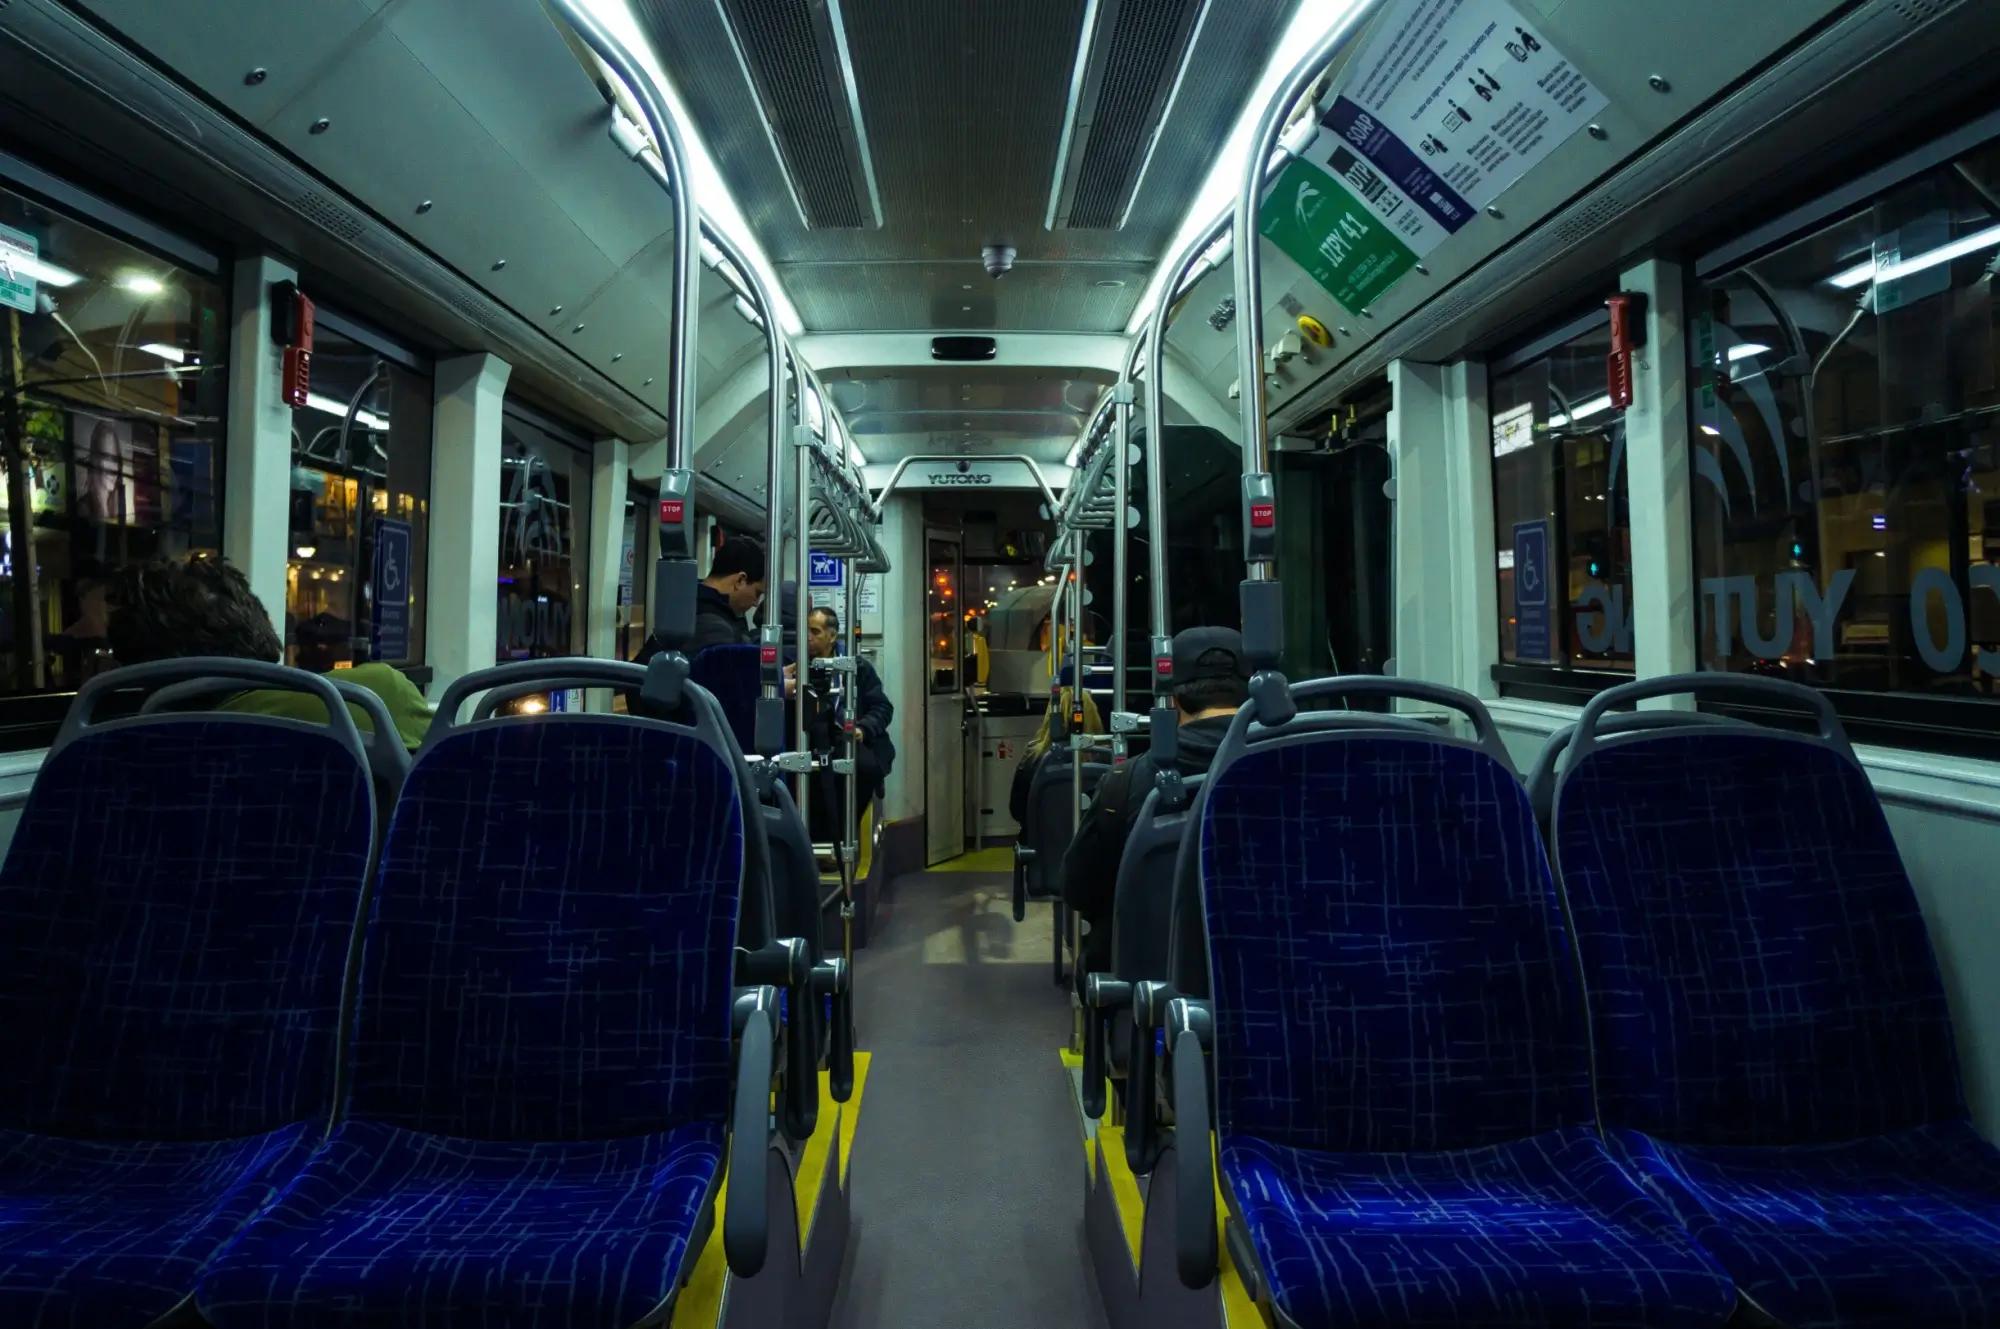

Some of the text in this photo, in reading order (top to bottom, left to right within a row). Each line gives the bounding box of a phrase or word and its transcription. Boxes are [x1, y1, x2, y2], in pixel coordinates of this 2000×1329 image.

[1346, 113, 1375, 146] SOAP
[1344, 160, 1373, 191] DTP
[1319, 227, 1352, 268] JZPY
[1339, 211, 1370, 240] 41
[928, 474, 992, 485] YUTONG
[662, 505, 681, 513] STOP
